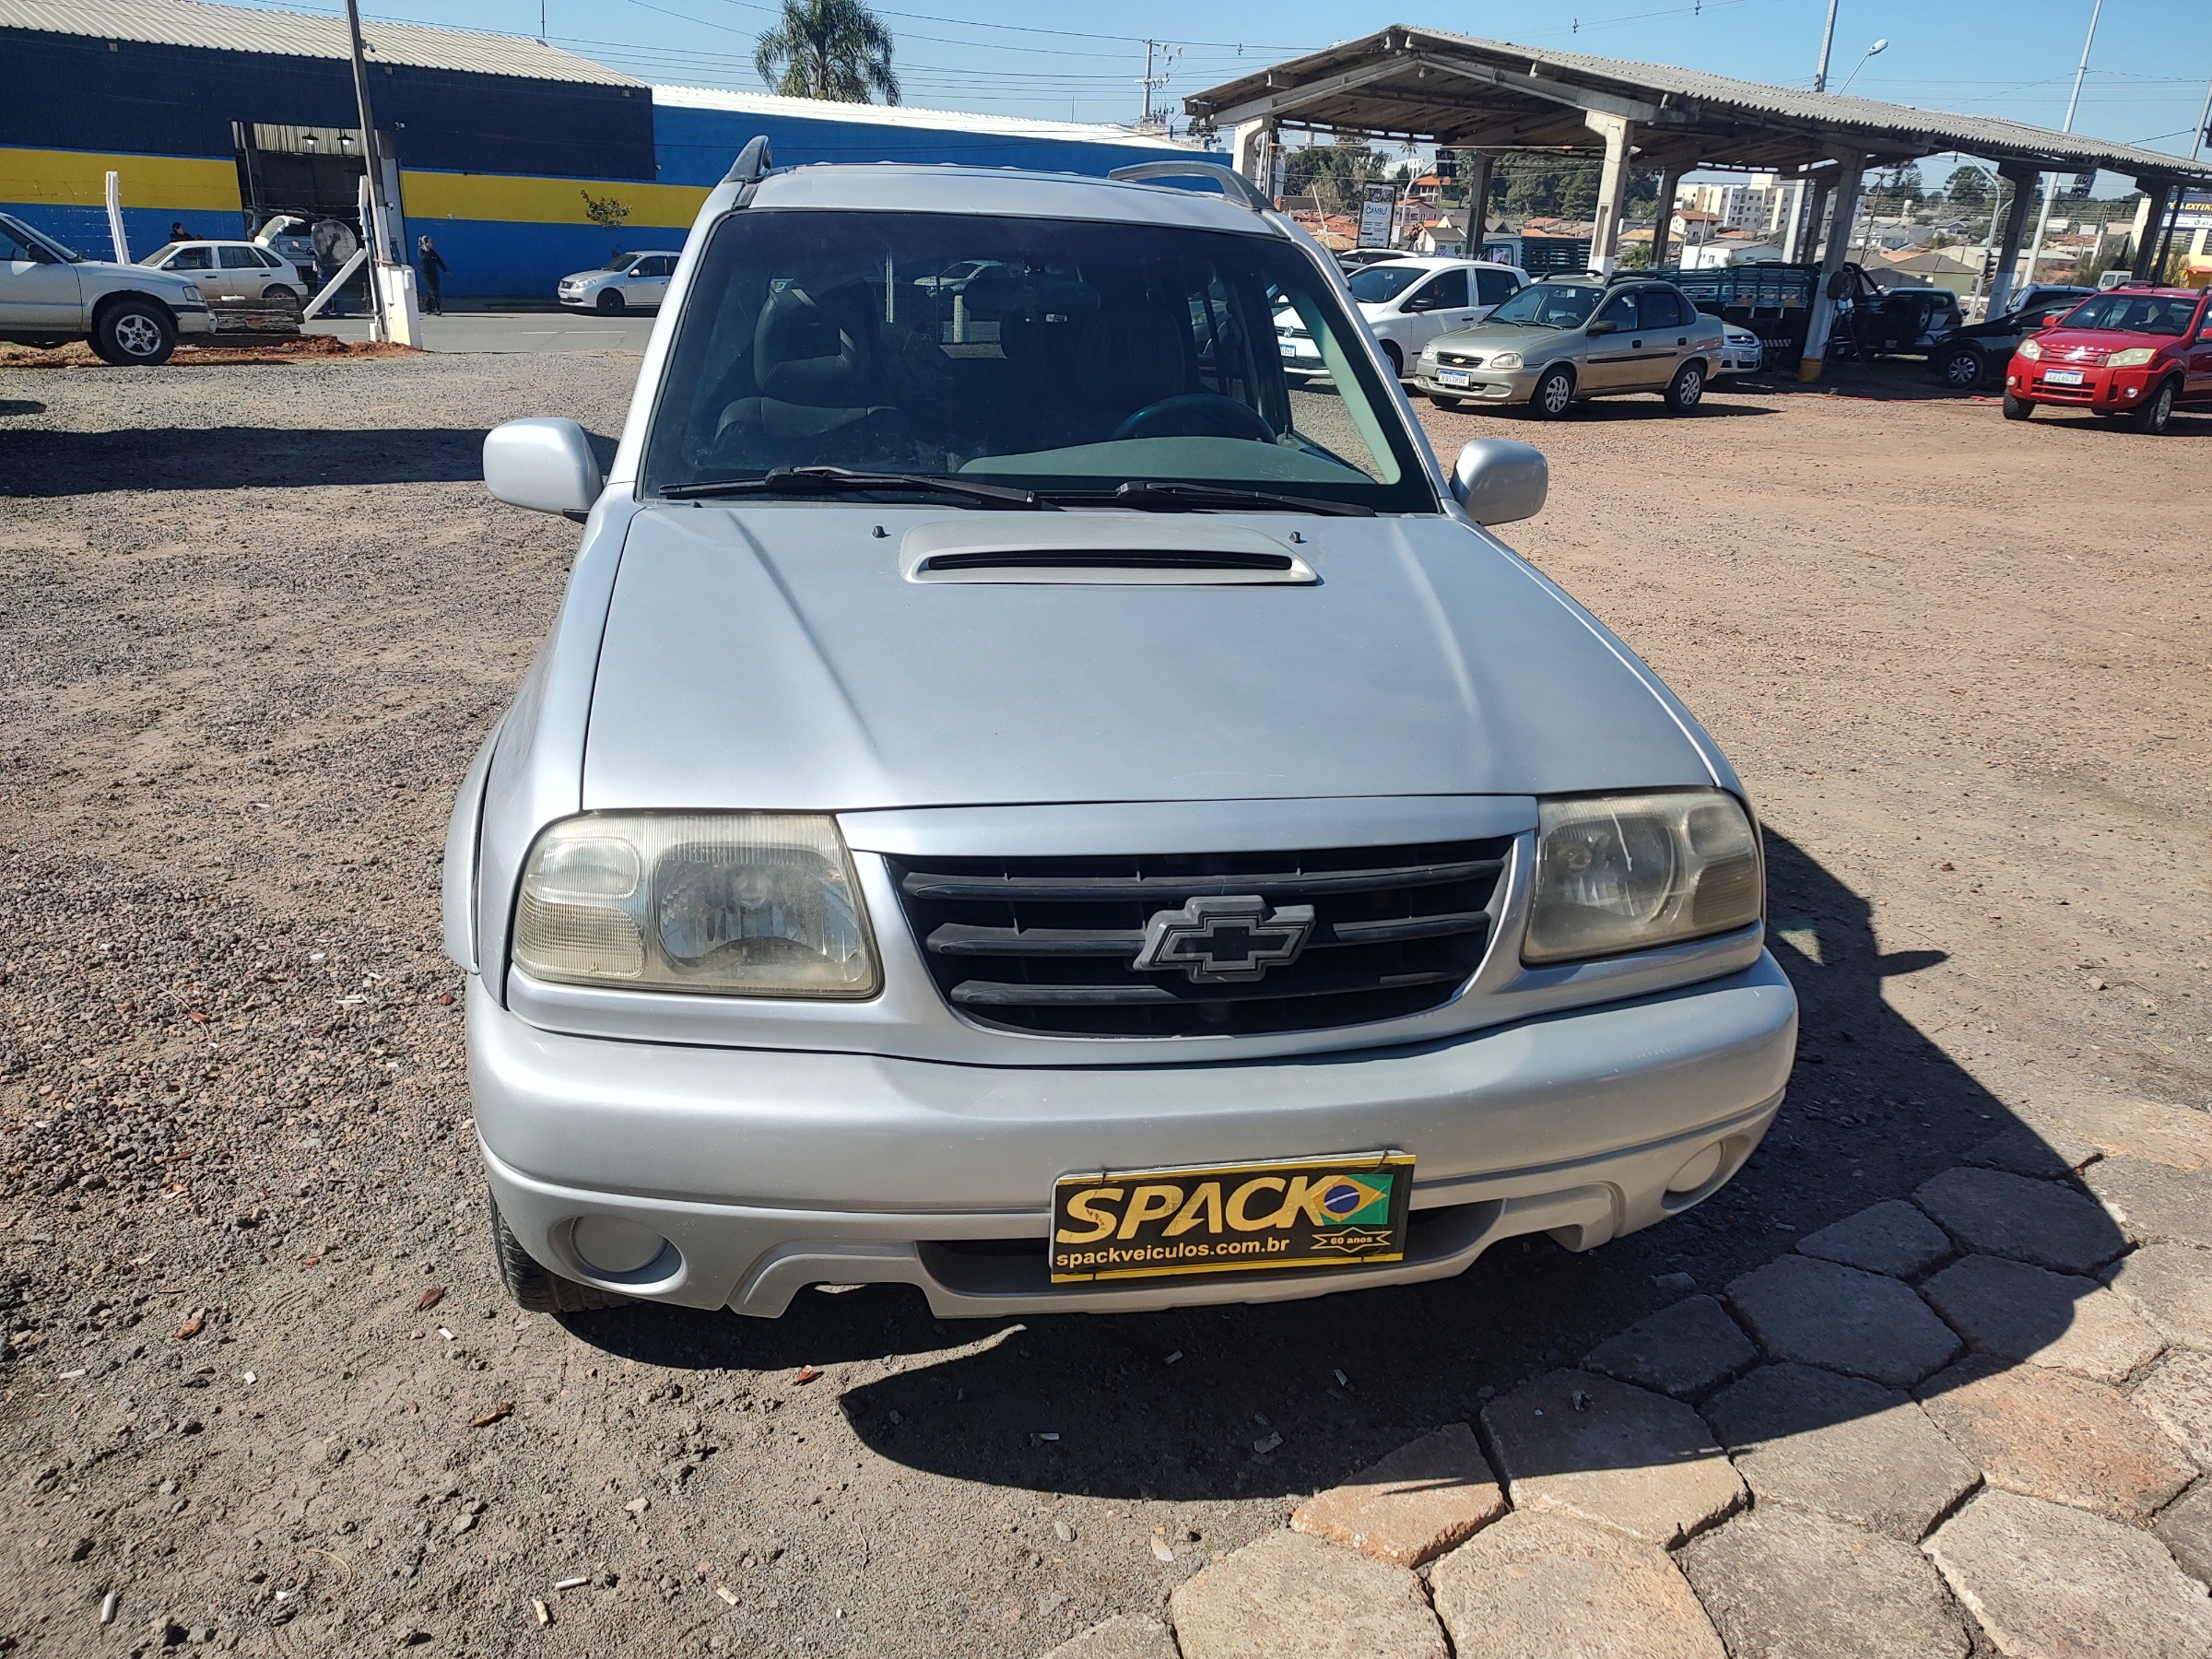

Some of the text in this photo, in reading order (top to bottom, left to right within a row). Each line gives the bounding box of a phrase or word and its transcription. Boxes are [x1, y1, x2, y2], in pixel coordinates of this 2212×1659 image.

[1055, 1175, 1339, 1244] SPACK
[1056, 1236, 1290, 1268] spackveiculos.com.br
[1330, 1236, 1372, 1245] 60 anos
